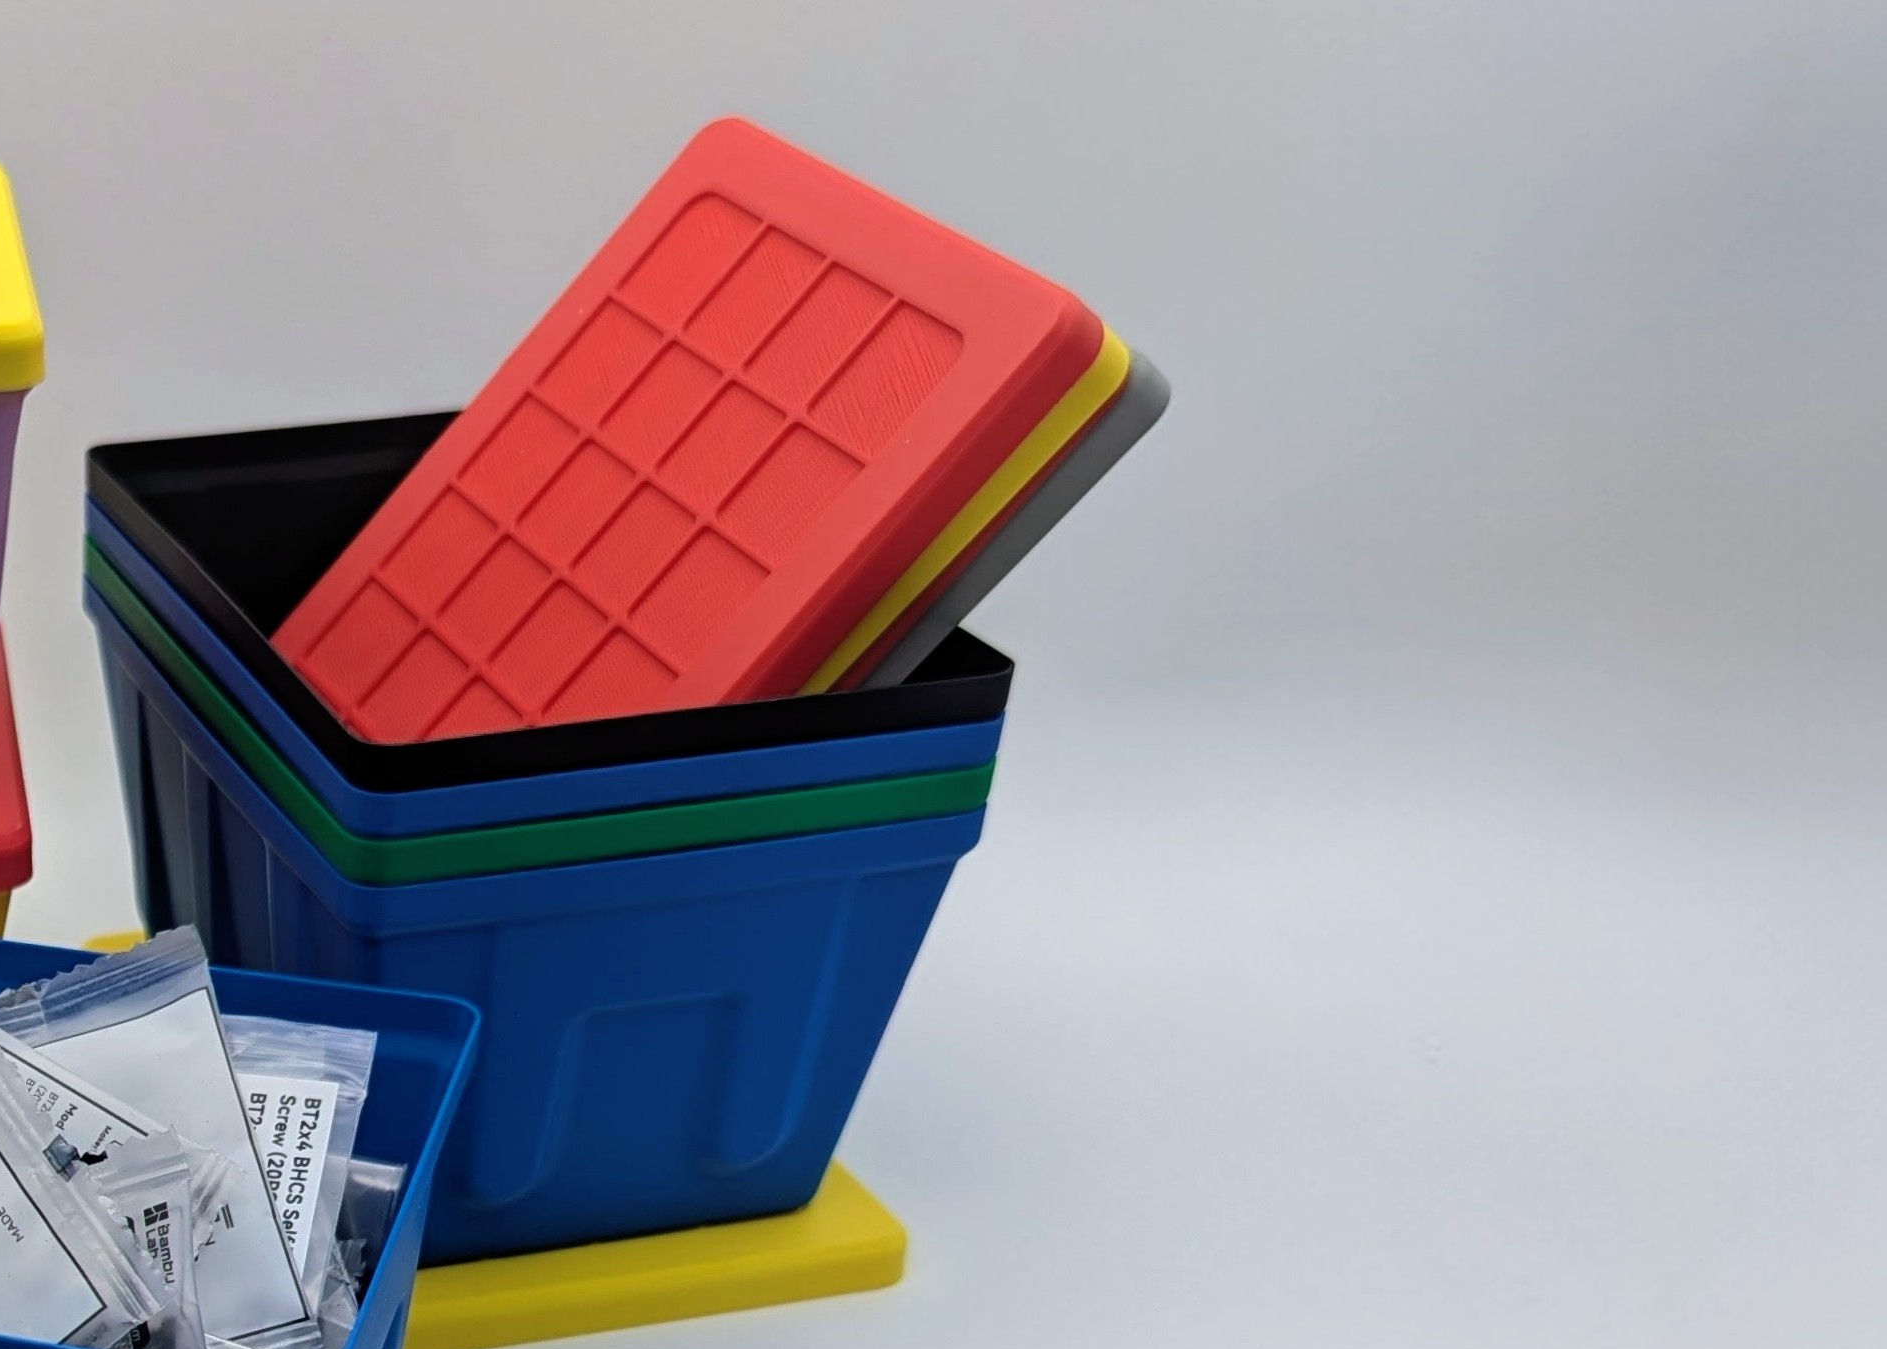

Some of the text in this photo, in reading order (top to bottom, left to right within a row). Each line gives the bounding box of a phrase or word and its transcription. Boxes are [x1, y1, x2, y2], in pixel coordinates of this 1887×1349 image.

[272, 1094, 297, 1147] Screw
[296, 1098, 322, 1152] BT2x4
[285, 1156, 311, 1205] BHCS
[157, 1223, 175, 1284] Bambu
